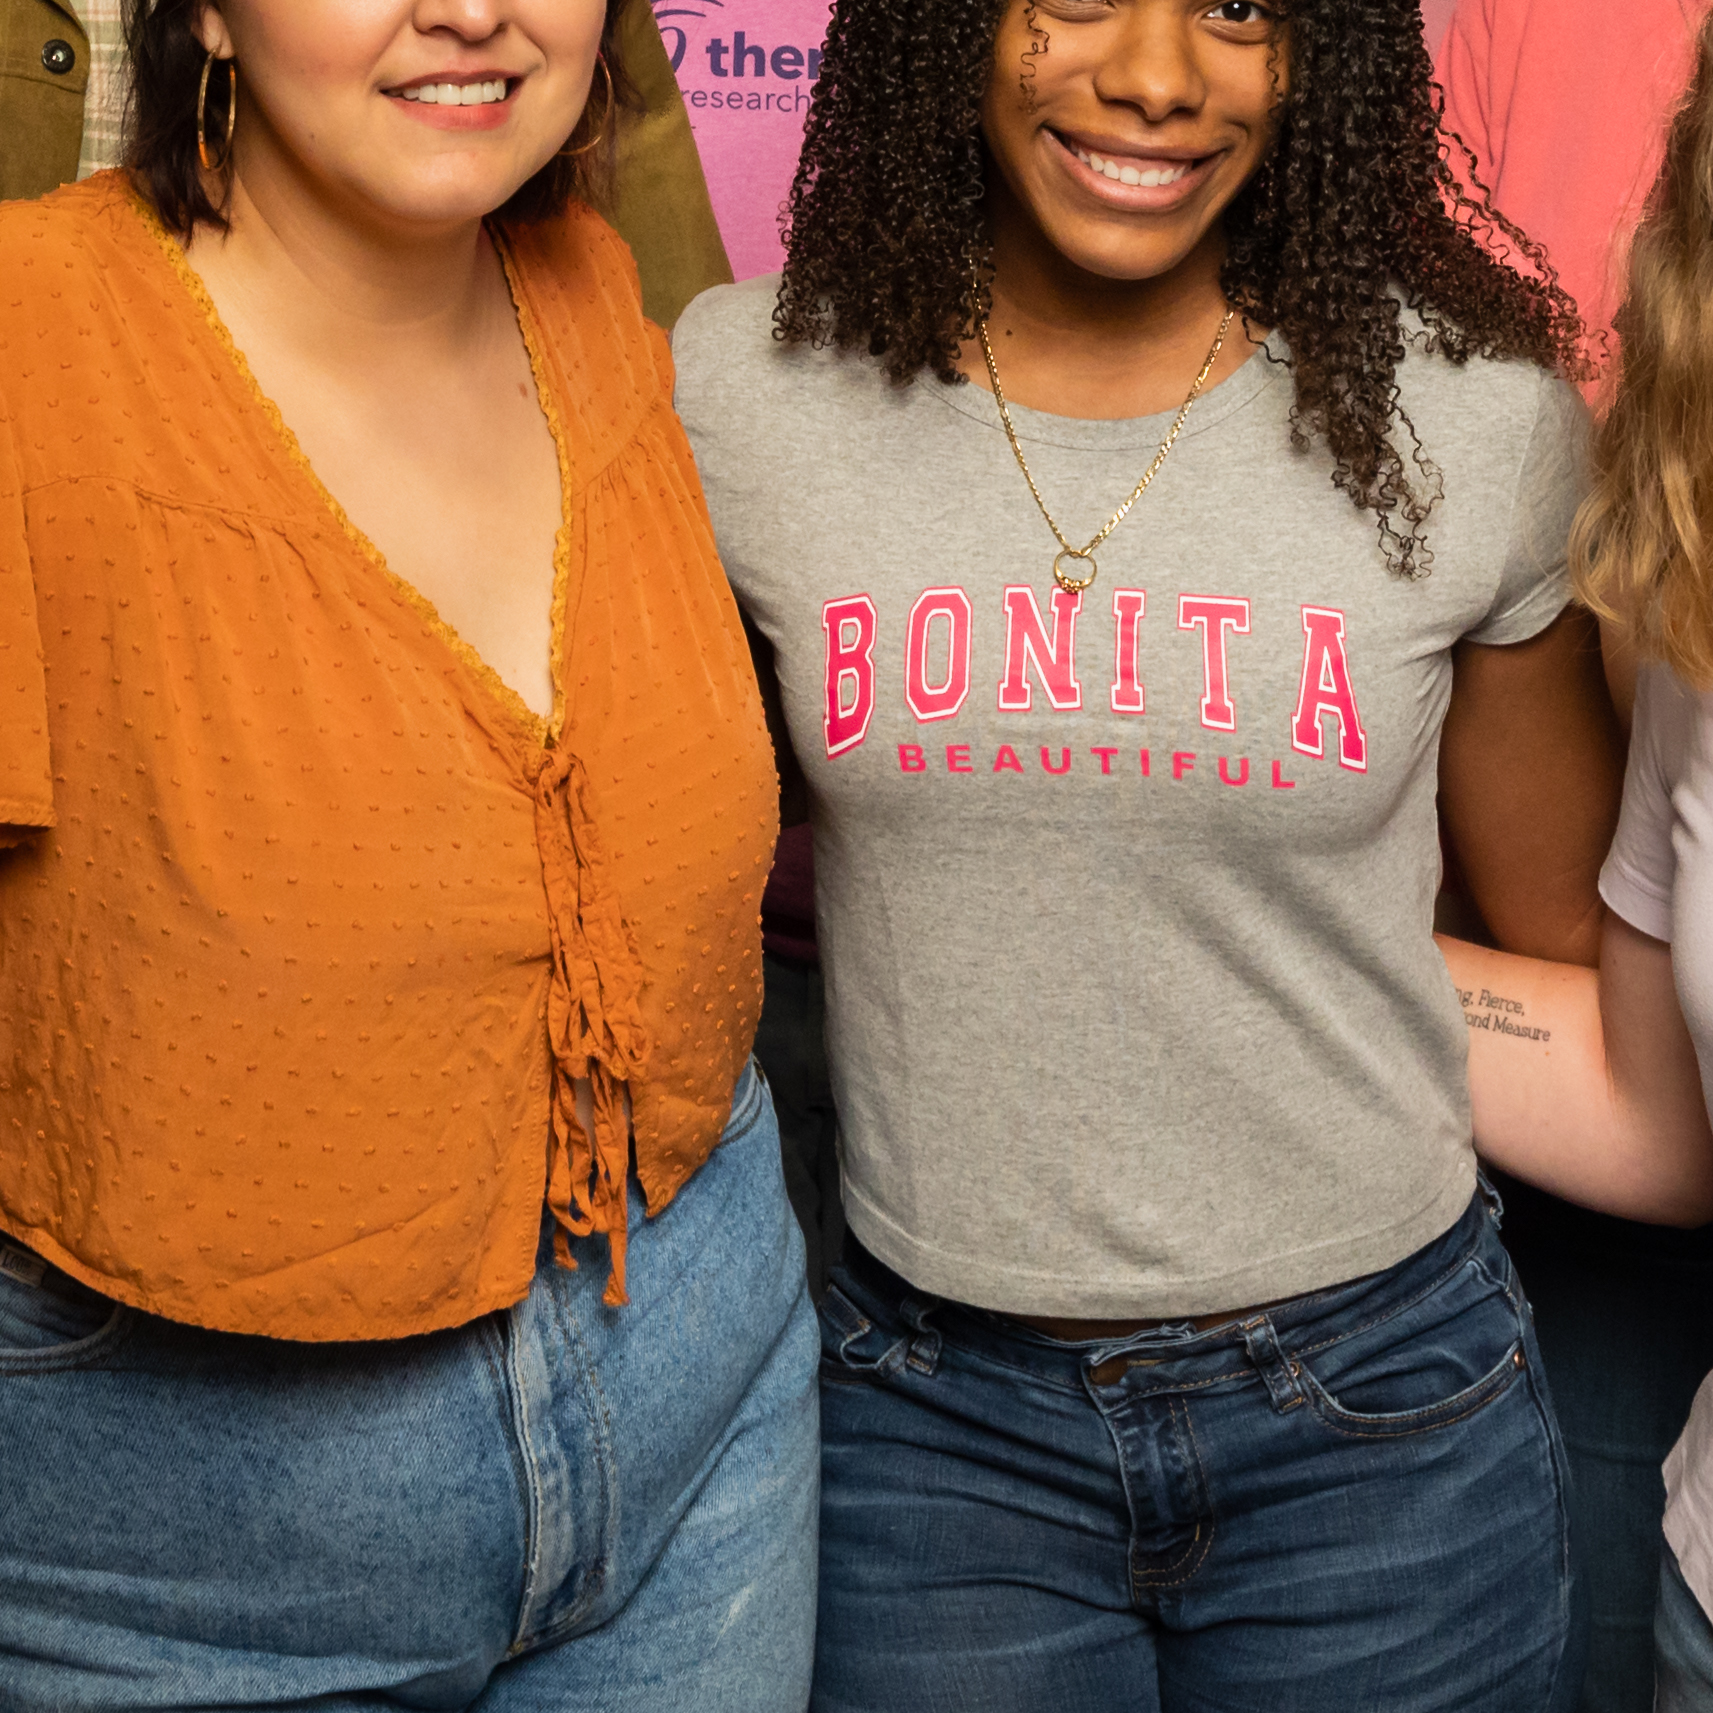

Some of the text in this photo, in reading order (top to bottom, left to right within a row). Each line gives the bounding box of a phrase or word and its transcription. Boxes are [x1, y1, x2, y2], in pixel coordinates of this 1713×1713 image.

[706, 31, 824, 80] ther
[689, 85, 811, 113] research
[821, 584, 1368, 774] BONITA
[897, 743, 1297, 789] BEAUTIFUL
[1478, 989, 1526, 1016] Fierce,
[1463, 1010, 1552, 1042] ond Measure
